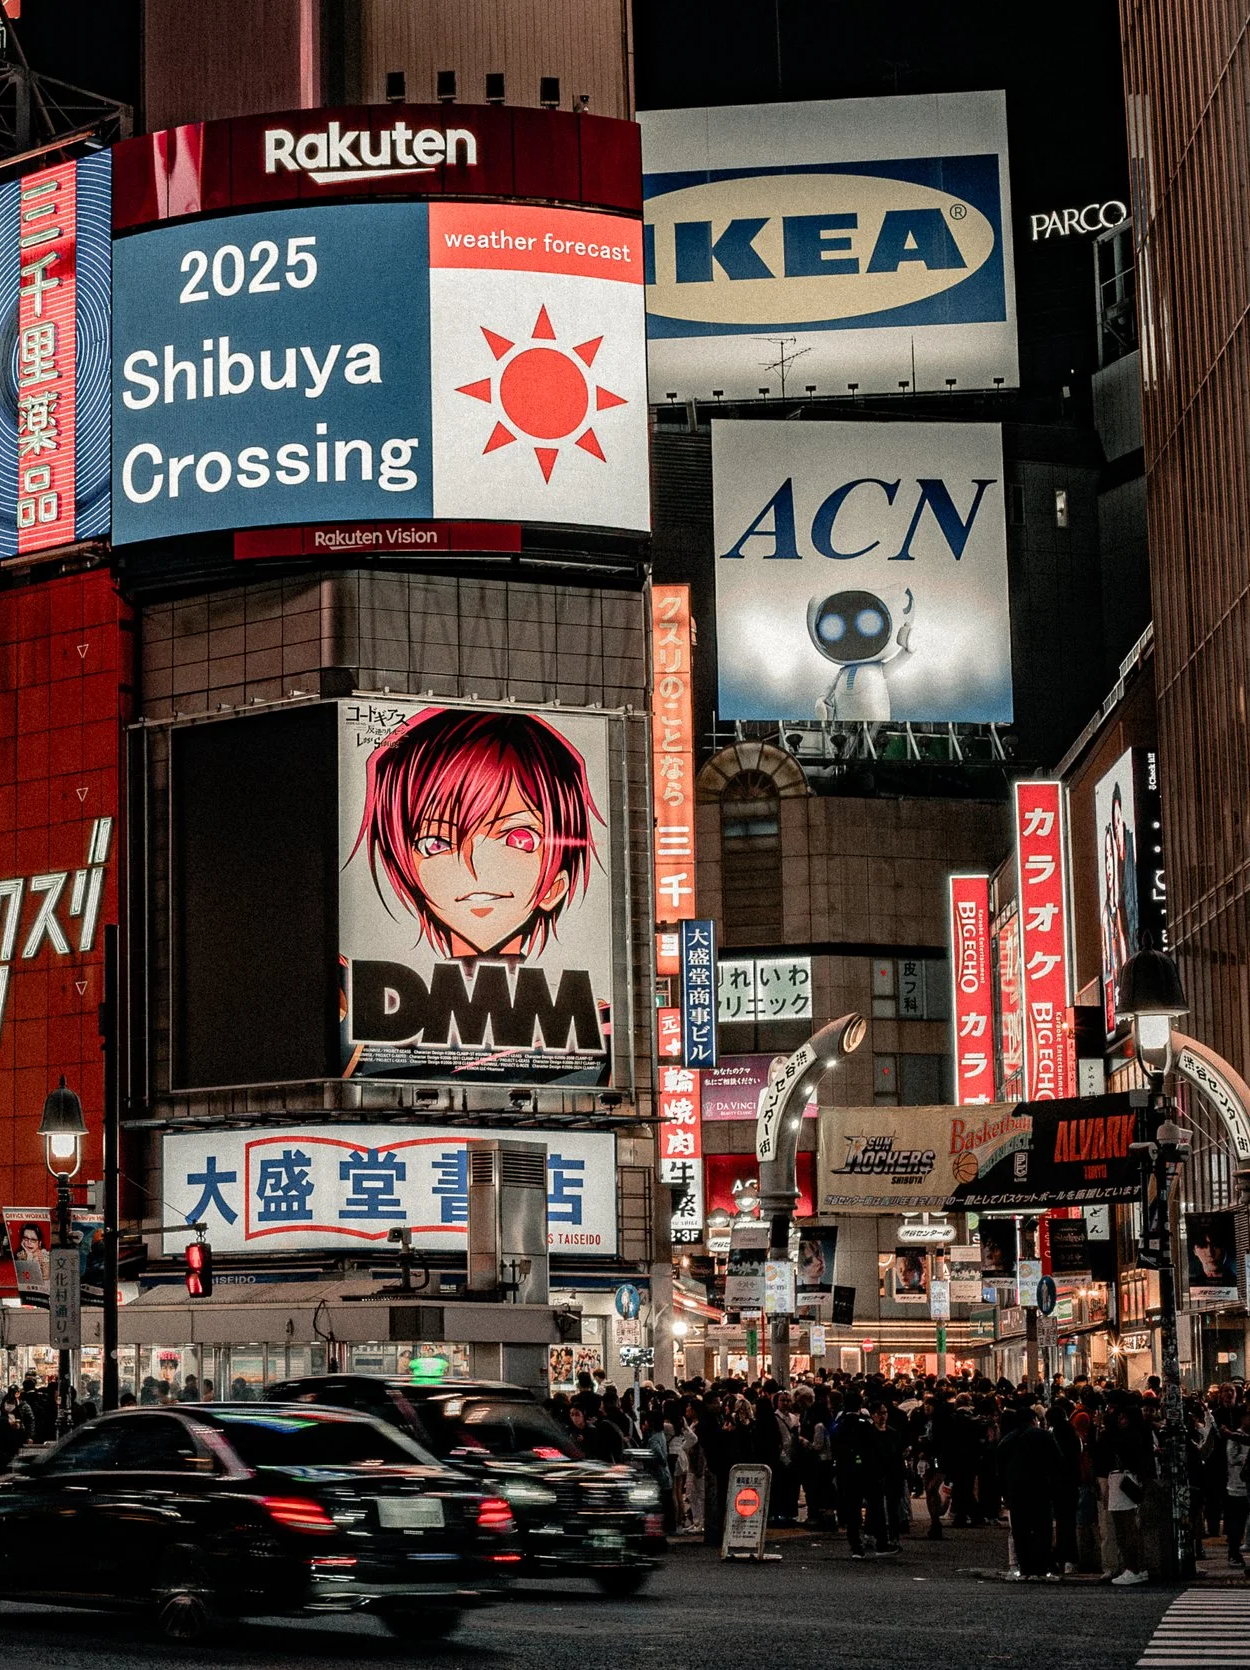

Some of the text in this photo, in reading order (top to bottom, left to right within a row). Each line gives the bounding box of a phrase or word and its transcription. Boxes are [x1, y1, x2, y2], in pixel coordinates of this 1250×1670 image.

[264, 121, 477, 177] Rakuten
[444, 229, 632, 263] weather forecast
[1030, 200, 1127, 242] PARCO
[179, 236, 317, 304] 2025
[17, 178, 64, 530] 三千里薬品
[122, 336, 382, 412] Shibuya
[121, 423, 419, 503] Crossing
[314, 527, 438, 550] Rakuten Vision
[718, 476, 997, 562] ACN
[346, 705, 410, 727] コードギアス
[1022, 807, 1062, 981] カラオケ
[957, 901, 980, 994] BIG ECHO
[350, 958, 606, 1052] DMM
[687, 927, 712, 1062] 大盛堂商事ビル
[717, 992, 811, 1019] リニック
[903, 961, 918, 1014] 皮フ科
[1031, 1002, 1054, 1045] BIG
[716, 1101, 757, 1110] DA VINCI
[759, 1050, 809, 1159] 渋谷センター街
[1183, 1054, 1249, 1154] 渋谷センター街
[865, 1137, 894, 1151] SUN
[891, 1175, 924, 1185] SHIBUYA
[558, 1232, 602, 1247] TAISEIDO
[54, 1257, 69, 1334] 文化村通り
